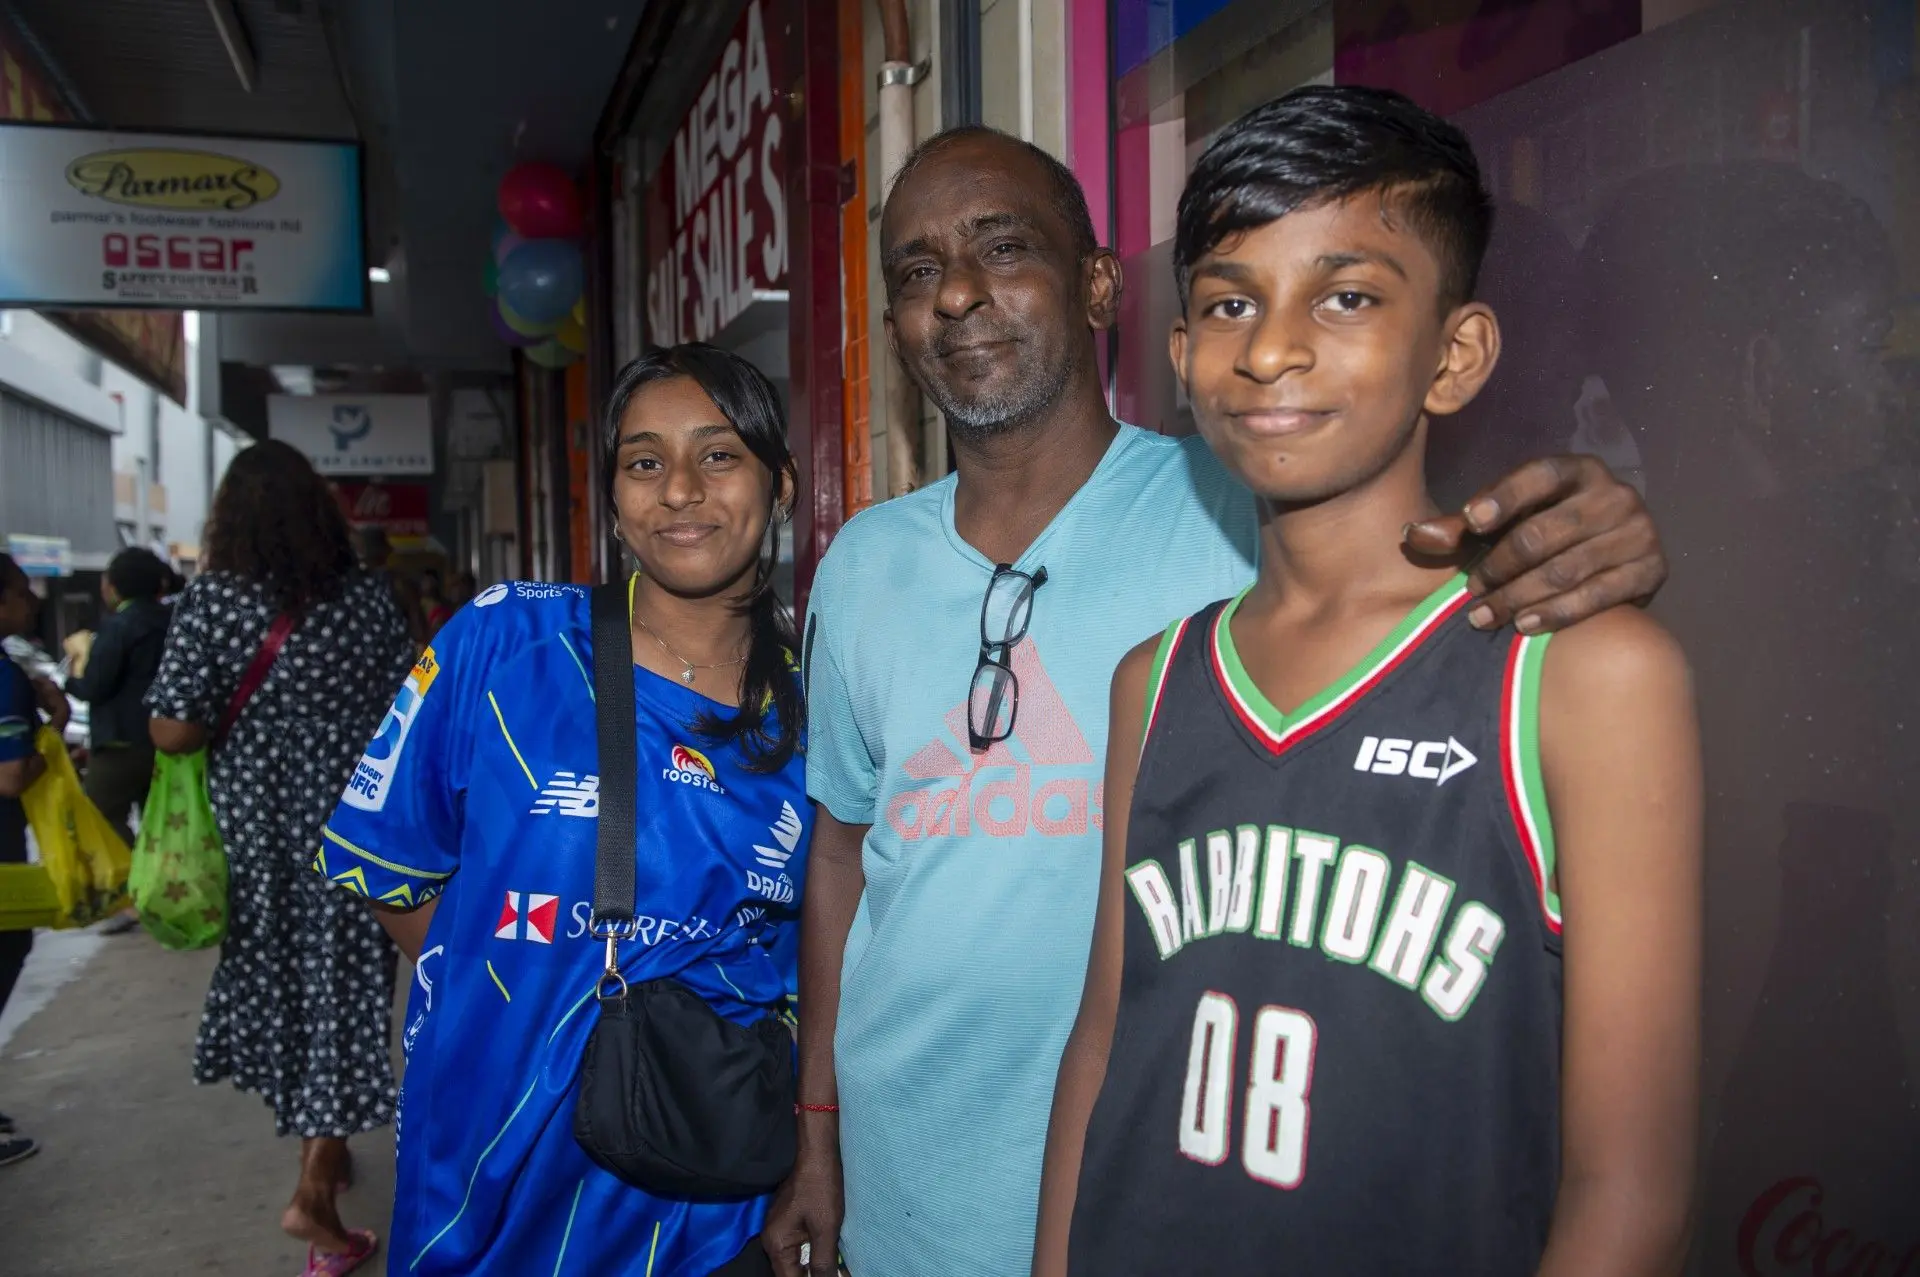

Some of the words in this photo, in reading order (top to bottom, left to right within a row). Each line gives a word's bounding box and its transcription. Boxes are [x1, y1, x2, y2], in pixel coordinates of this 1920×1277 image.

[674, 0, 771, 230] MEGA
[102, 231, 255, 272] oscar
[516, 586, 563, 600] Sports
[358, 760, 384, 784] RUGBY
[1354, 736, 1443, 780] ISC
[662, 766, 725, 795] rooster
[1124, 824, 1505, 1022] RABBITOHS
[1178, 990, 1318, 1190] 08
